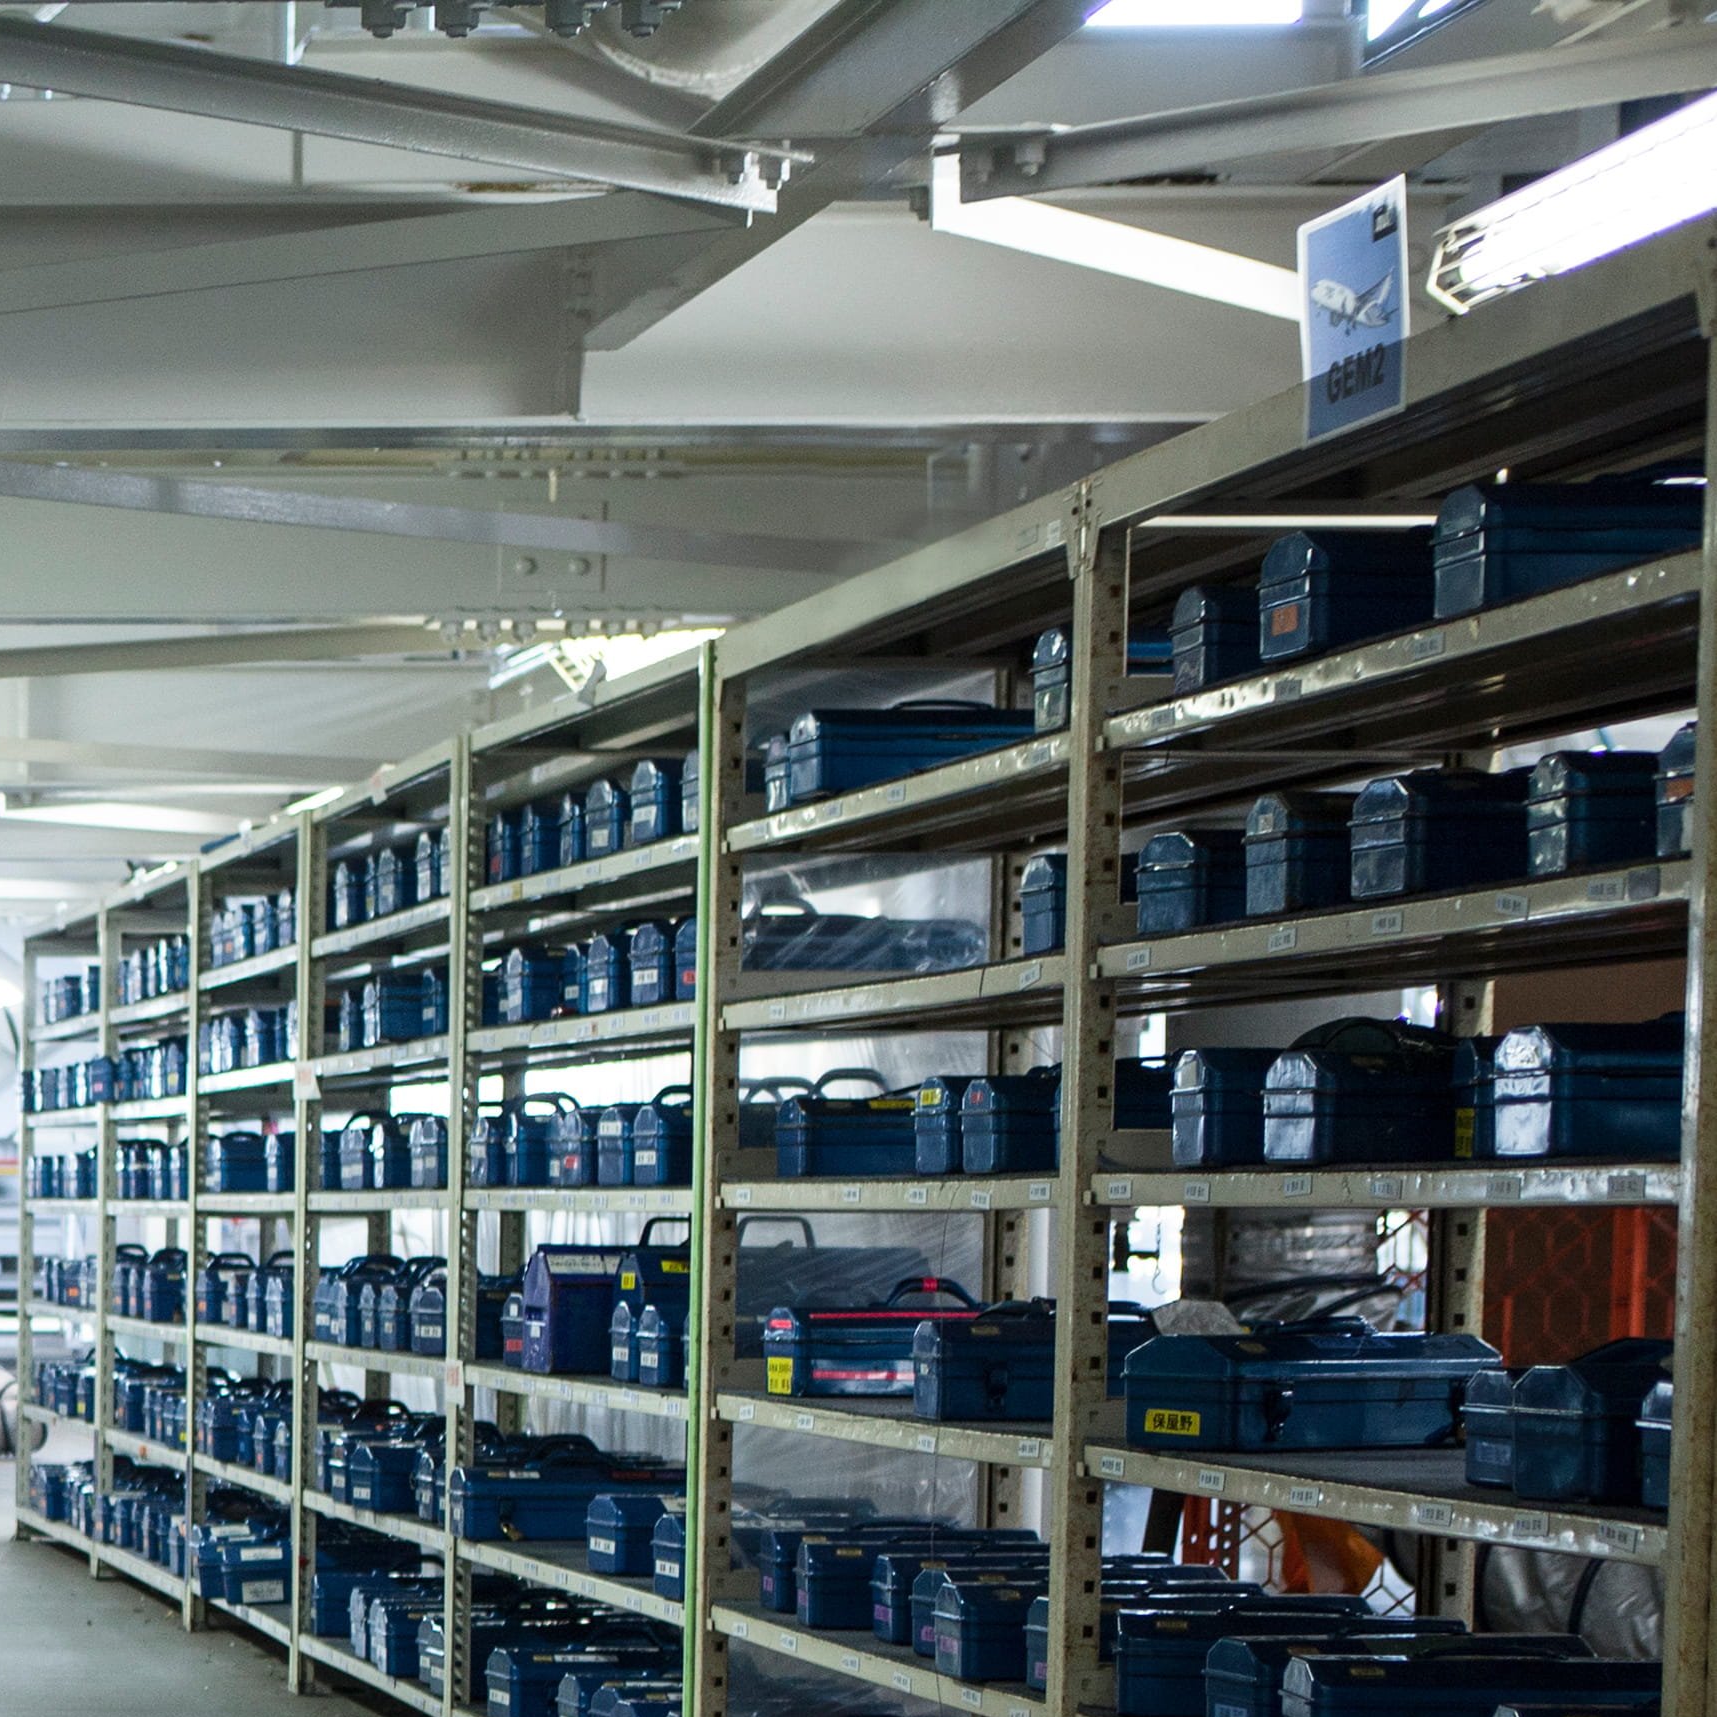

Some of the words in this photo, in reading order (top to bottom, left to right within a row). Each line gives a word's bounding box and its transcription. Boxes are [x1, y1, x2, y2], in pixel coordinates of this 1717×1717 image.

[1327, 343, 1385, 404] GEM2
[1152, 1412, 1194, 1433] 保屋野
